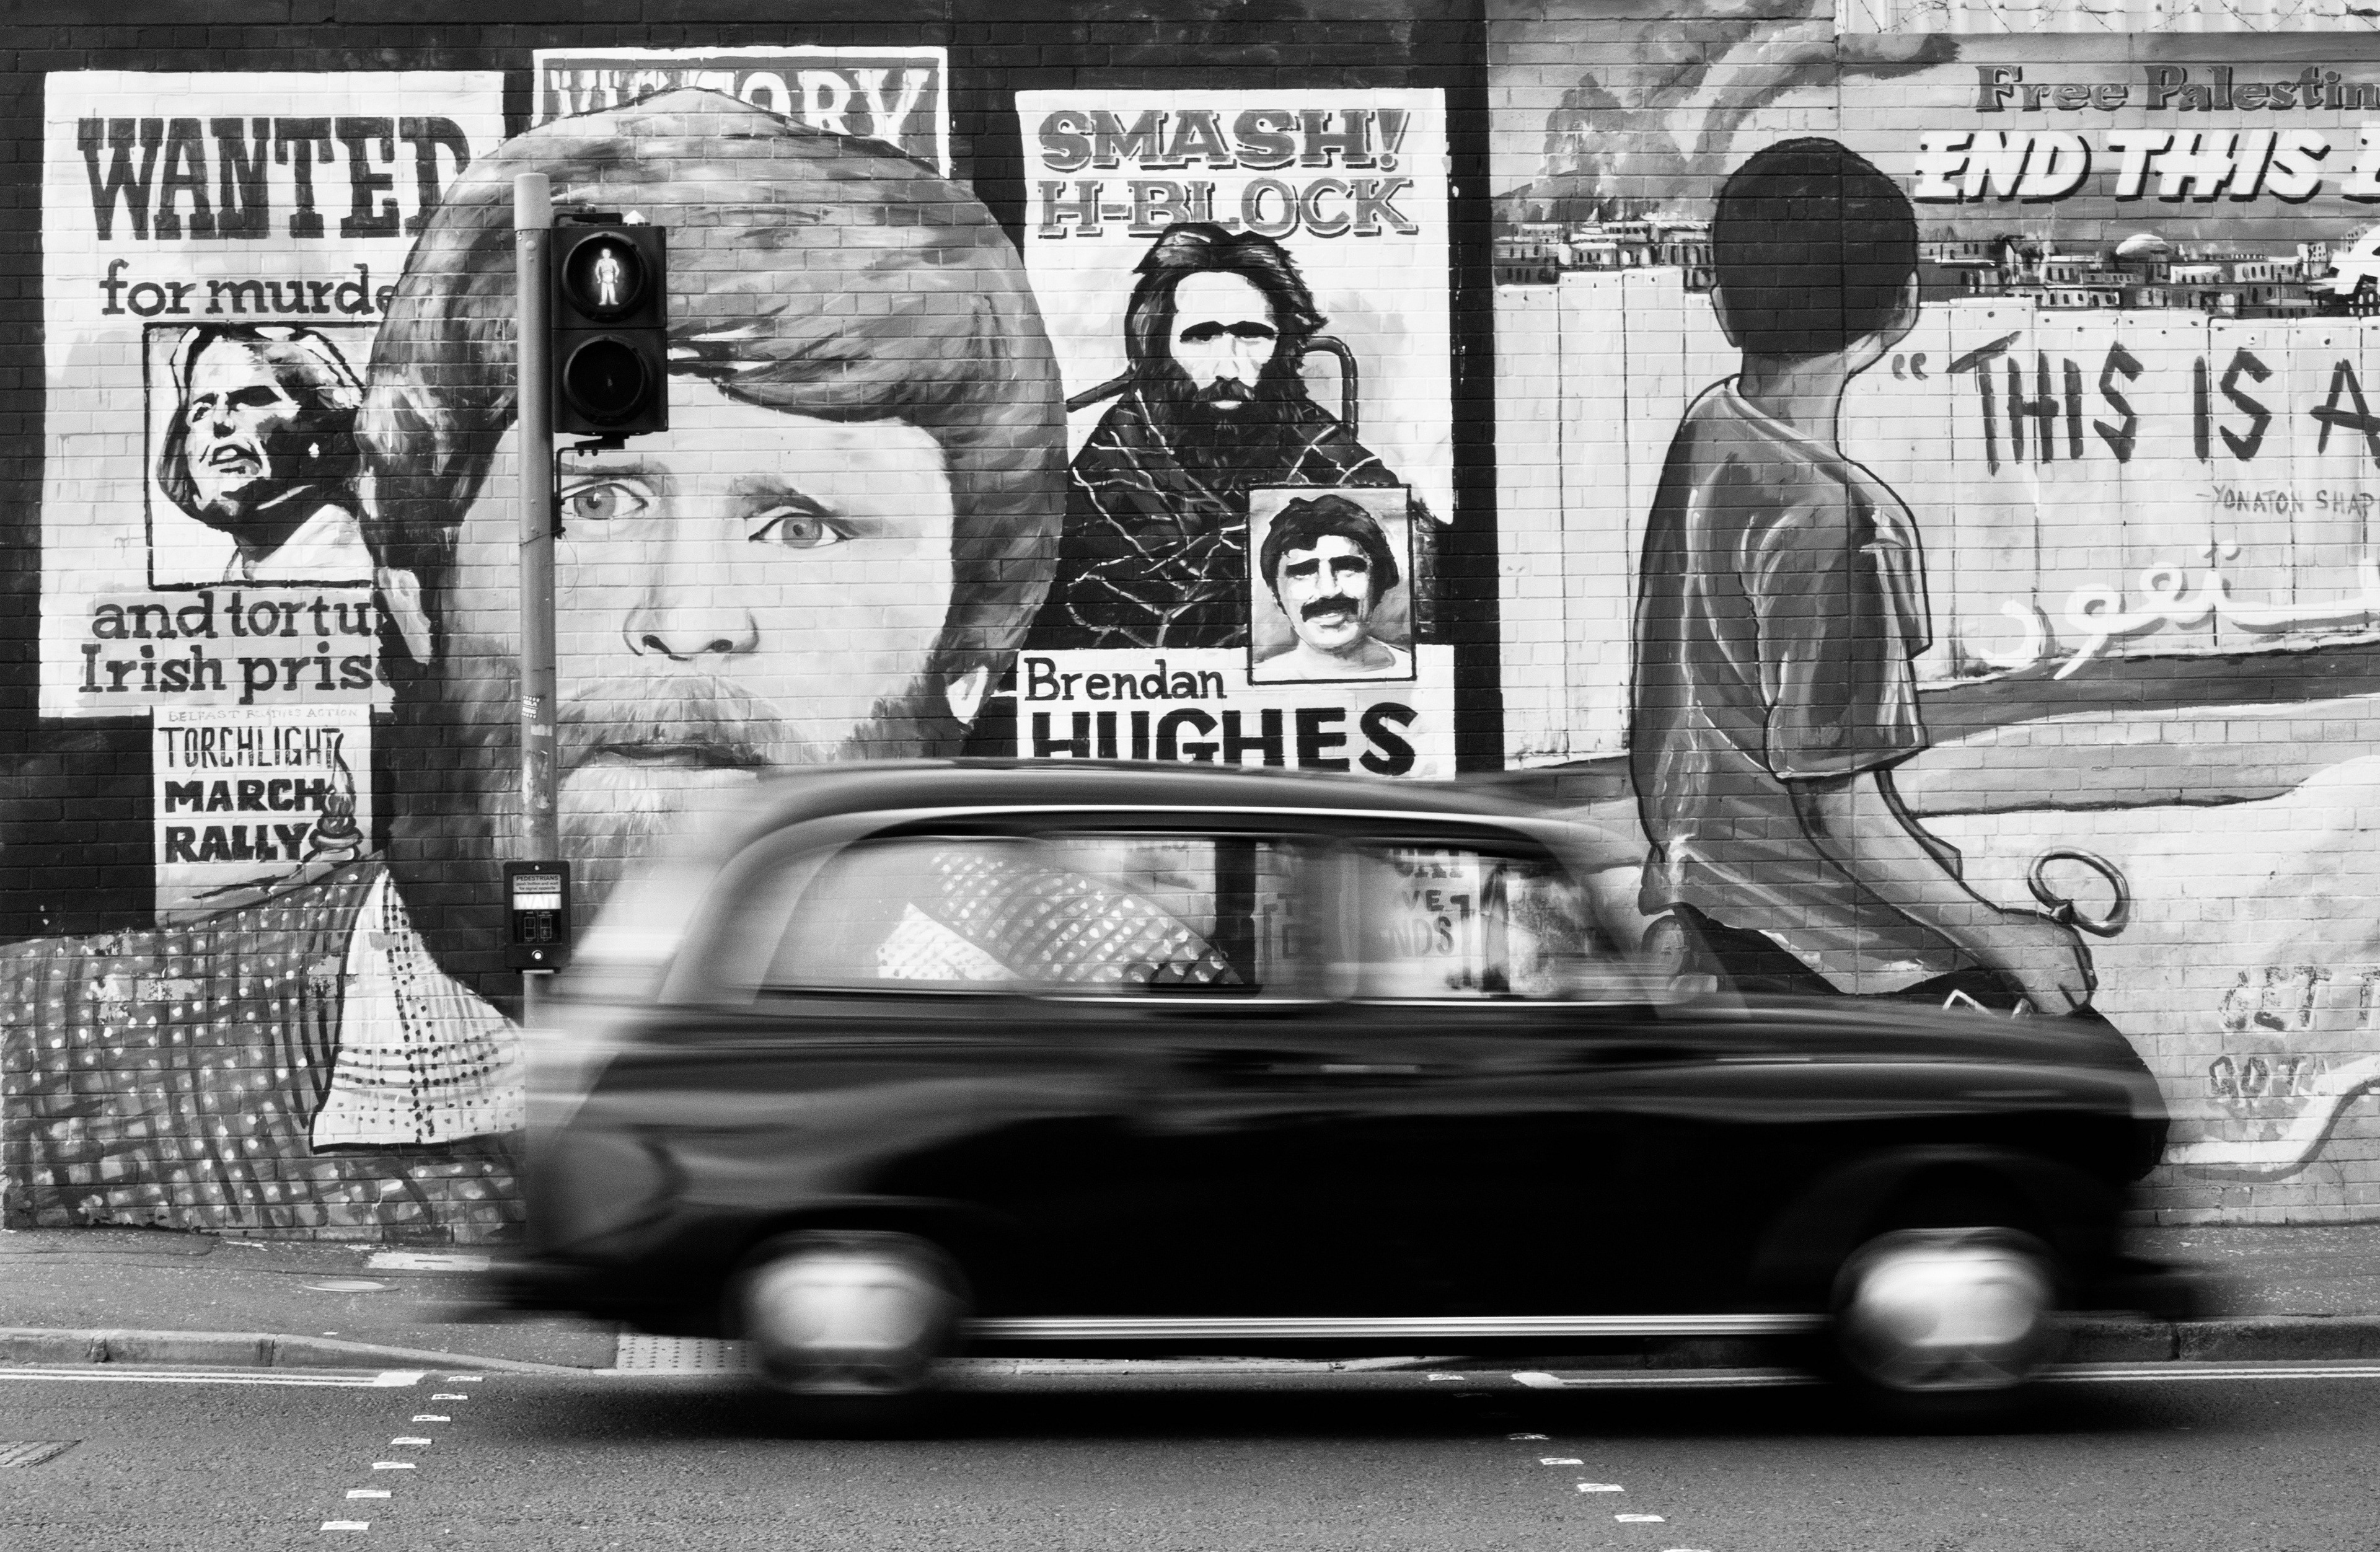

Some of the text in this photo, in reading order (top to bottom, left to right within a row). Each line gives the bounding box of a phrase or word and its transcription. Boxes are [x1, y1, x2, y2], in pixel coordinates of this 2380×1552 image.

[1975, 65, 2128, 112] Free
[1038, 108, 1410, 172] SMASH!
[78, 117, 470, 240] WANTED
[1913, 130, 2091, 203] END
[2107, 130, 2330, 203] THIS
[1038, 177, 1419, 239] H-BLOCK
[99, 258, 196, 316] for
[2193, 346, 2273, 464] IS
[2310, 359, 2380, 470] A
[92, 591, 218, 639] and
[79, 643, 227, 693] Irish
[1023, 656, 1227, 701] Brendan
[169, 710, 240, 721] BELFAST
[306, 708, 358, 718] ACTION
[1032, 701, 1419, 776] HUGHES
[158, 726, 340, 769] TORCHLIGHT
[165, 778, 326, 812] MARCH
[165, 822, 315, 863] RALLY
[517, 894, 558, 909] WAIT
